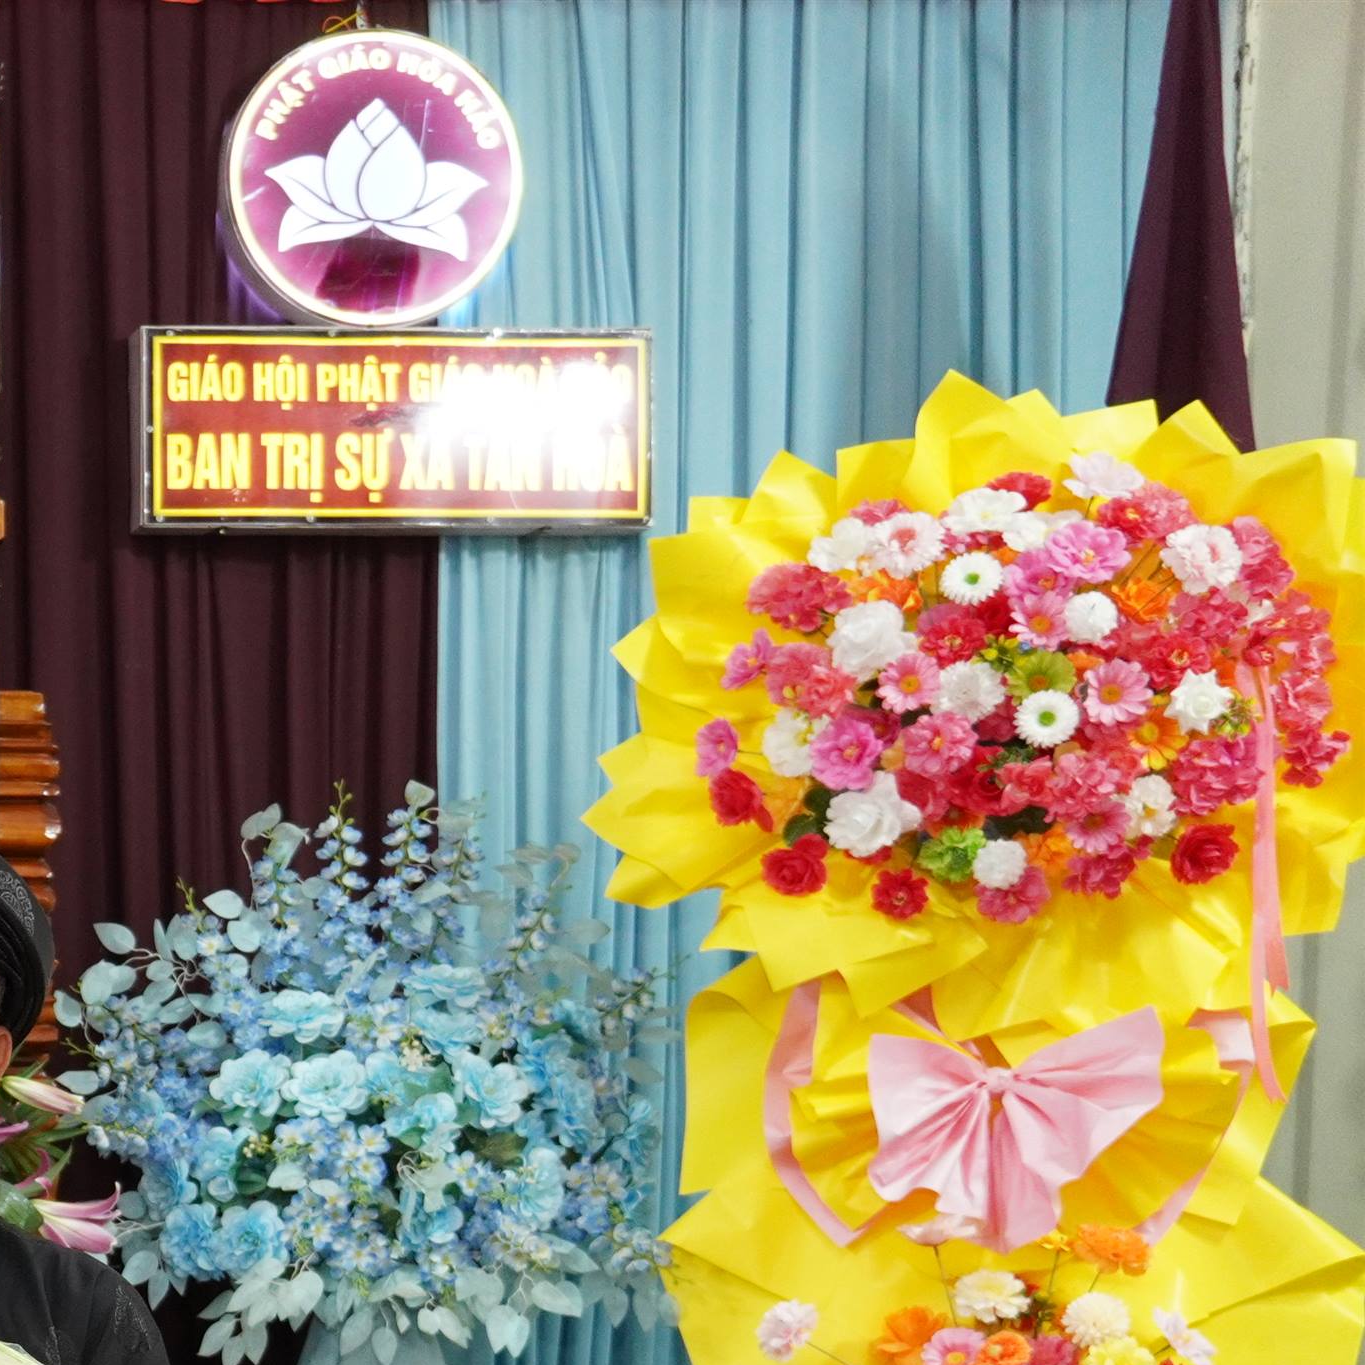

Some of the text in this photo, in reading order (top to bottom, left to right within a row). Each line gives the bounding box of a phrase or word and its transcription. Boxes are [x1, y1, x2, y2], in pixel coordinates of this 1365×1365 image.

[167, 355, 245, 402] GIÁO
[252, 355, 309, 412] HỘI
[316, 355, 402, 412] PHẬT
[167, 433, 250, 491] BAN
[261, 433, 323, 503] TRỊ
[334, 427, 394, 503] SỰ
